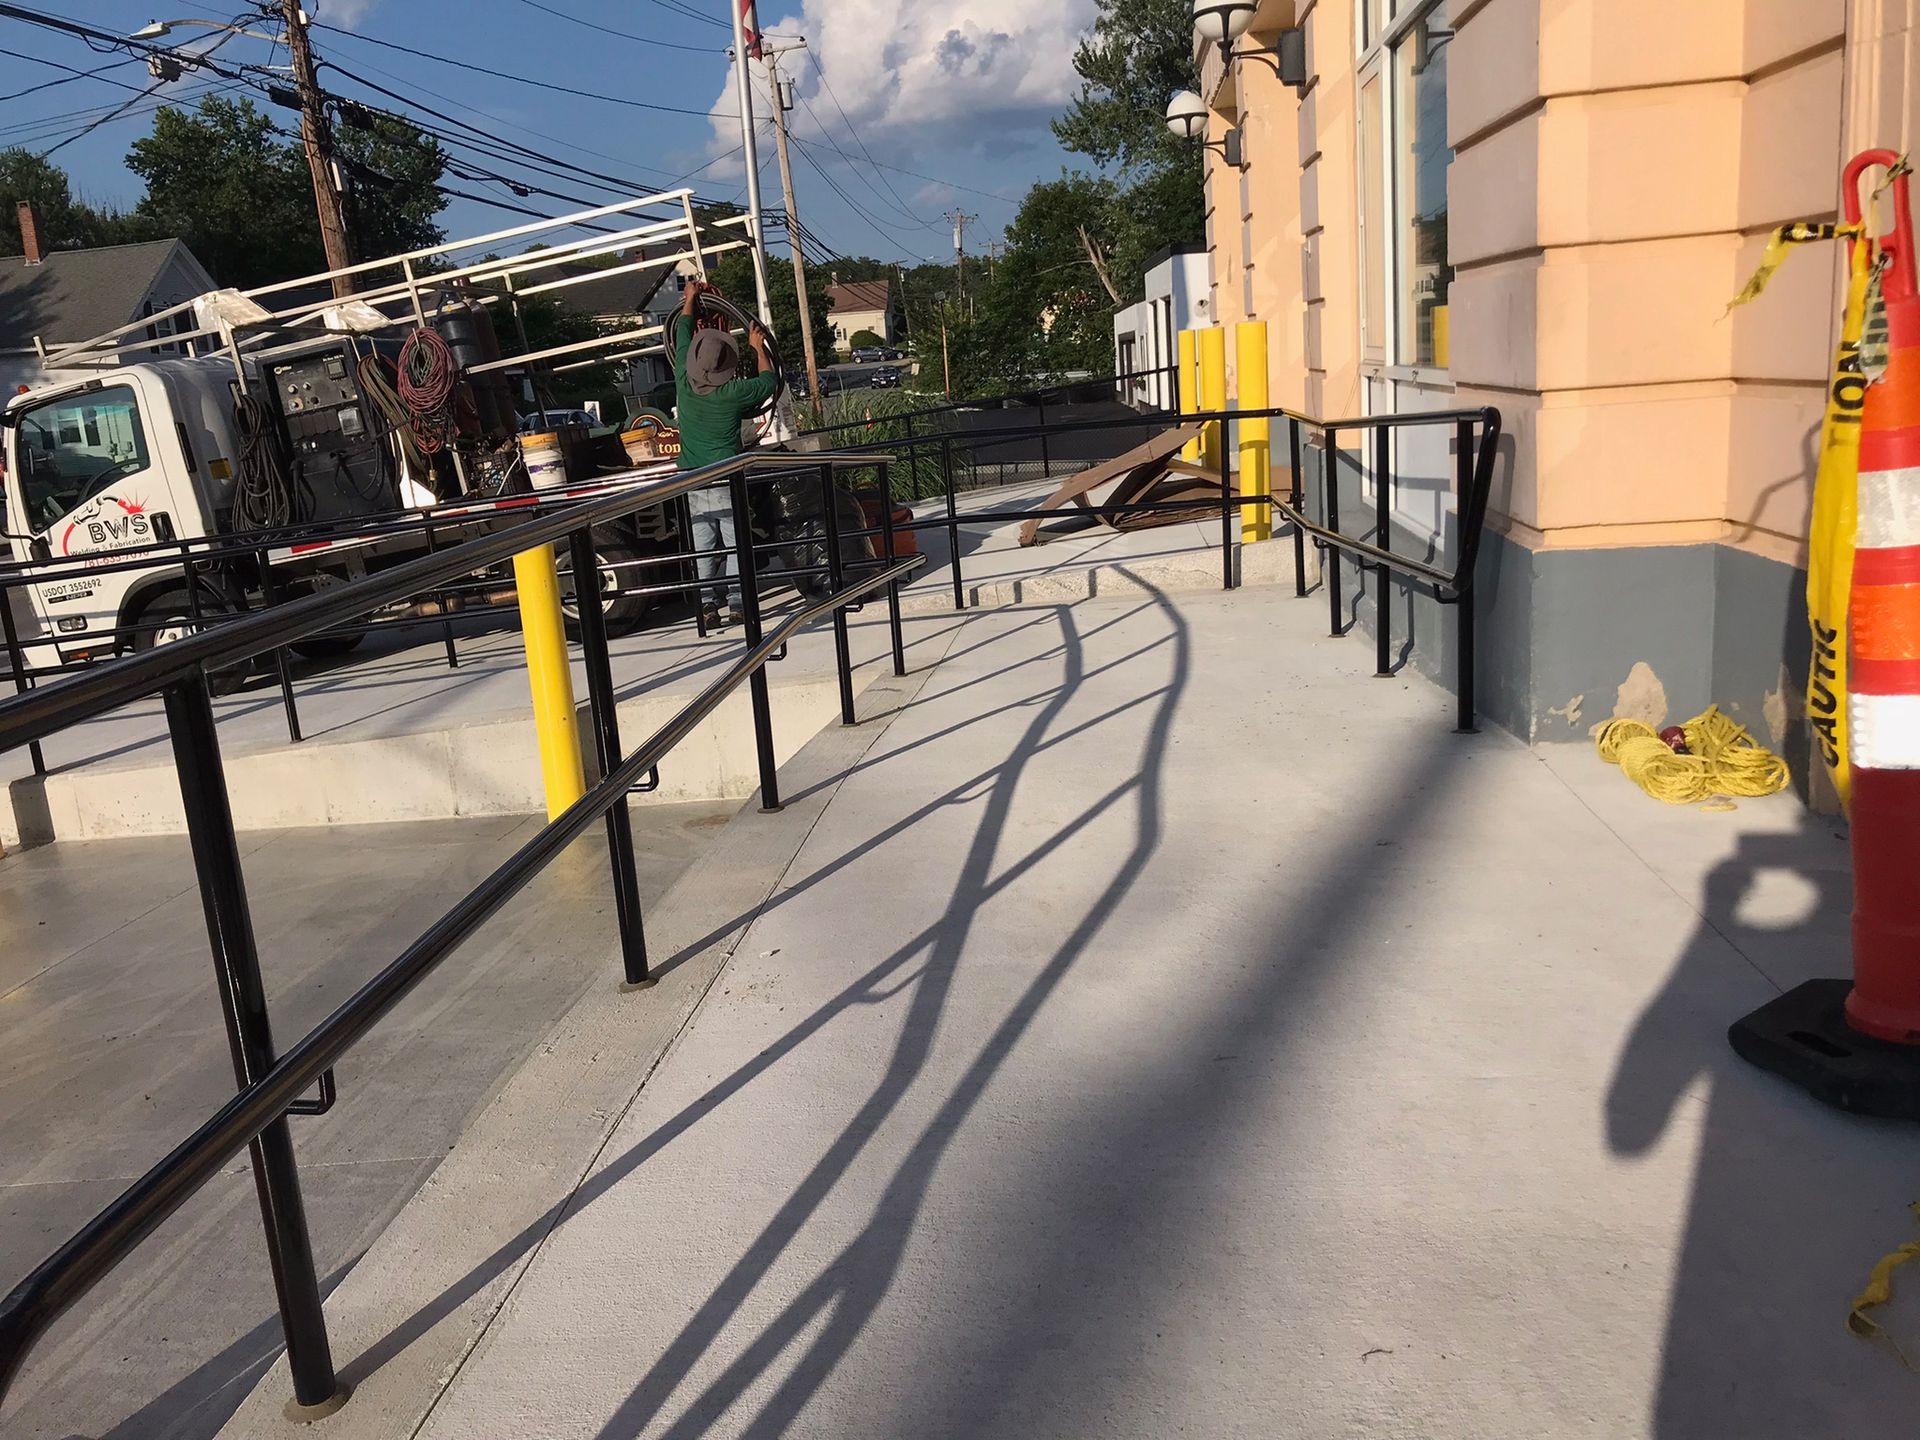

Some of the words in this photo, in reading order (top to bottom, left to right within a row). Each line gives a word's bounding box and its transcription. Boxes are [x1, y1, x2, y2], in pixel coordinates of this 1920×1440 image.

[88, 514, 149, 543] BWS
[109, 536, 151, 549] Fabrication
[42, 585, 68, 598] USDOT
[69, 578, 102, 592] 3552692
